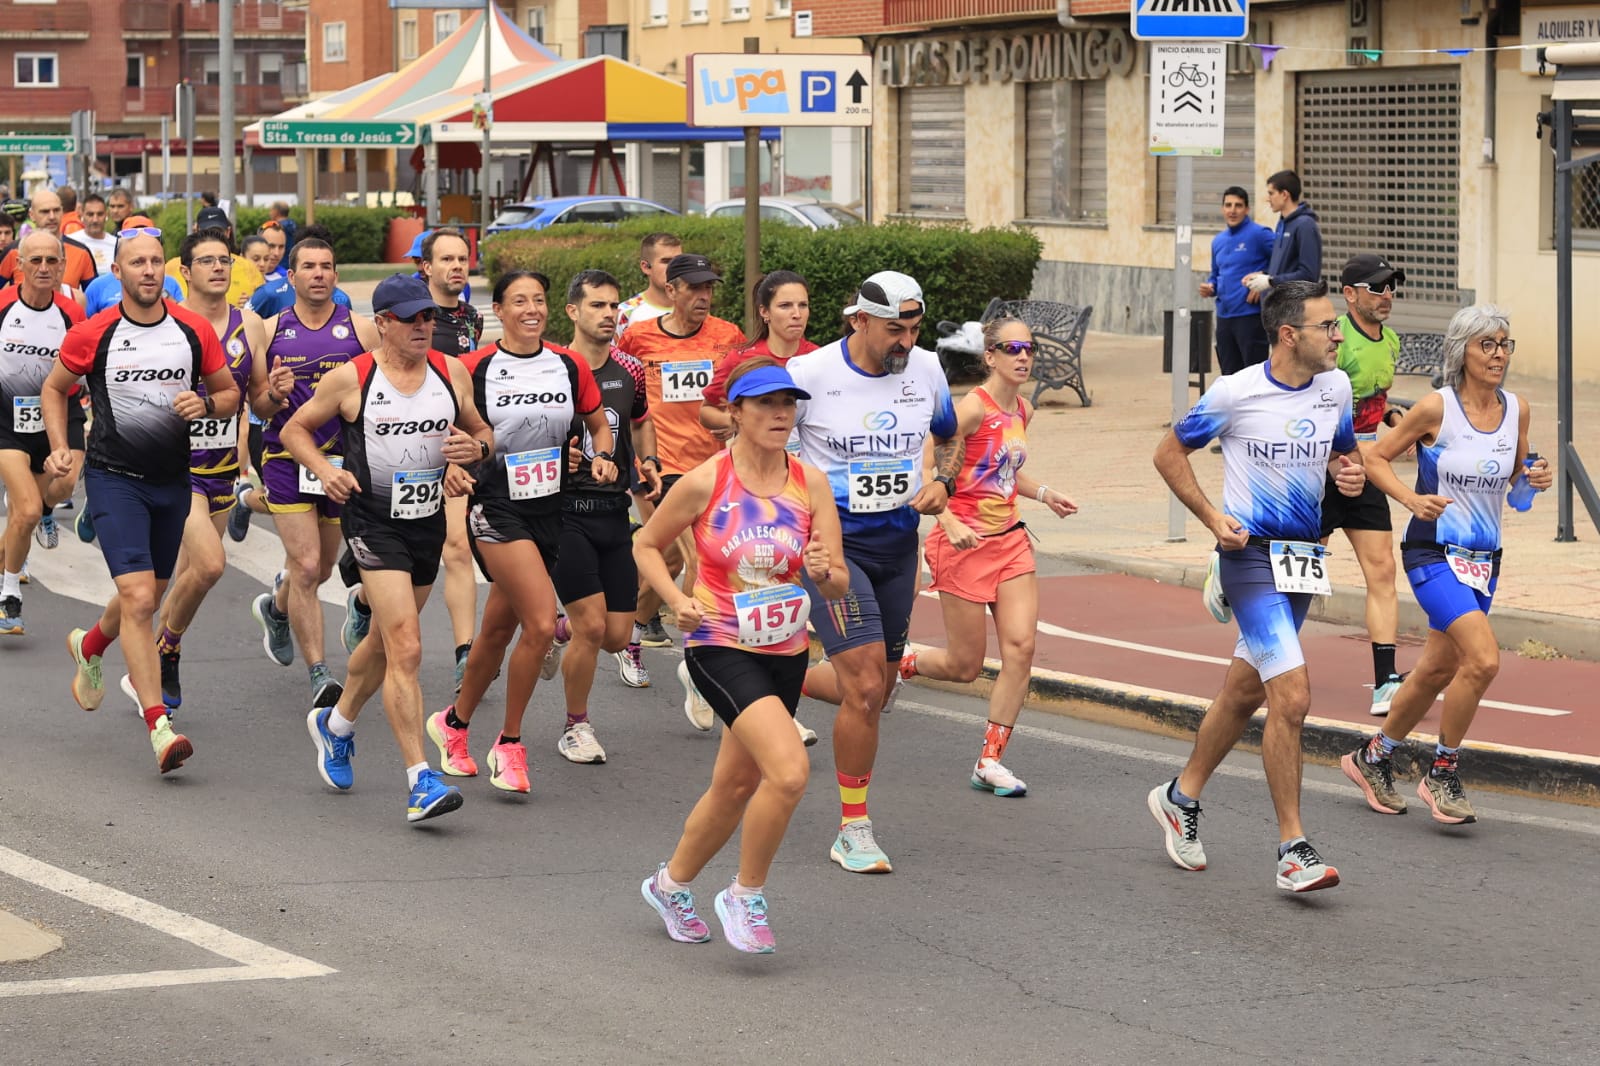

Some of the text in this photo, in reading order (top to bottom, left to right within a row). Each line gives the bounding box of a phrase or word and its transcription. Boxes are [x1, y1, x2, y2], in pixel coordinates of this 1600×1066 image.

[1537, 20, 1585, 40] ALQUILER
[953, 38, 988, 85] DE
[992, 29, 1131, 82] DOMINGO
[700, 68, 786, 111] lupa
[807, 76, 831, 108] P
[266, 132, 392, 142] Sta. Teresa de Jesús
[114, 368, 186, 382] 37300
[668, 371, 708, 390] 140
[496, 392, 567, 407] 37300
[190, 418, 232, 436] 287
[375, 419, 448, 435] 37300
[515, 461, 557, 486] 515
[856, 473, 908, 497] 355
[398, 481, 439, 504] 292
[721, 525, 802, 558] BAR LA ESCAPADA
[755, 544, 775, 556] RUN
[1279, 555, 1323, 579] 175
[747, 598, 803, 632] 157
